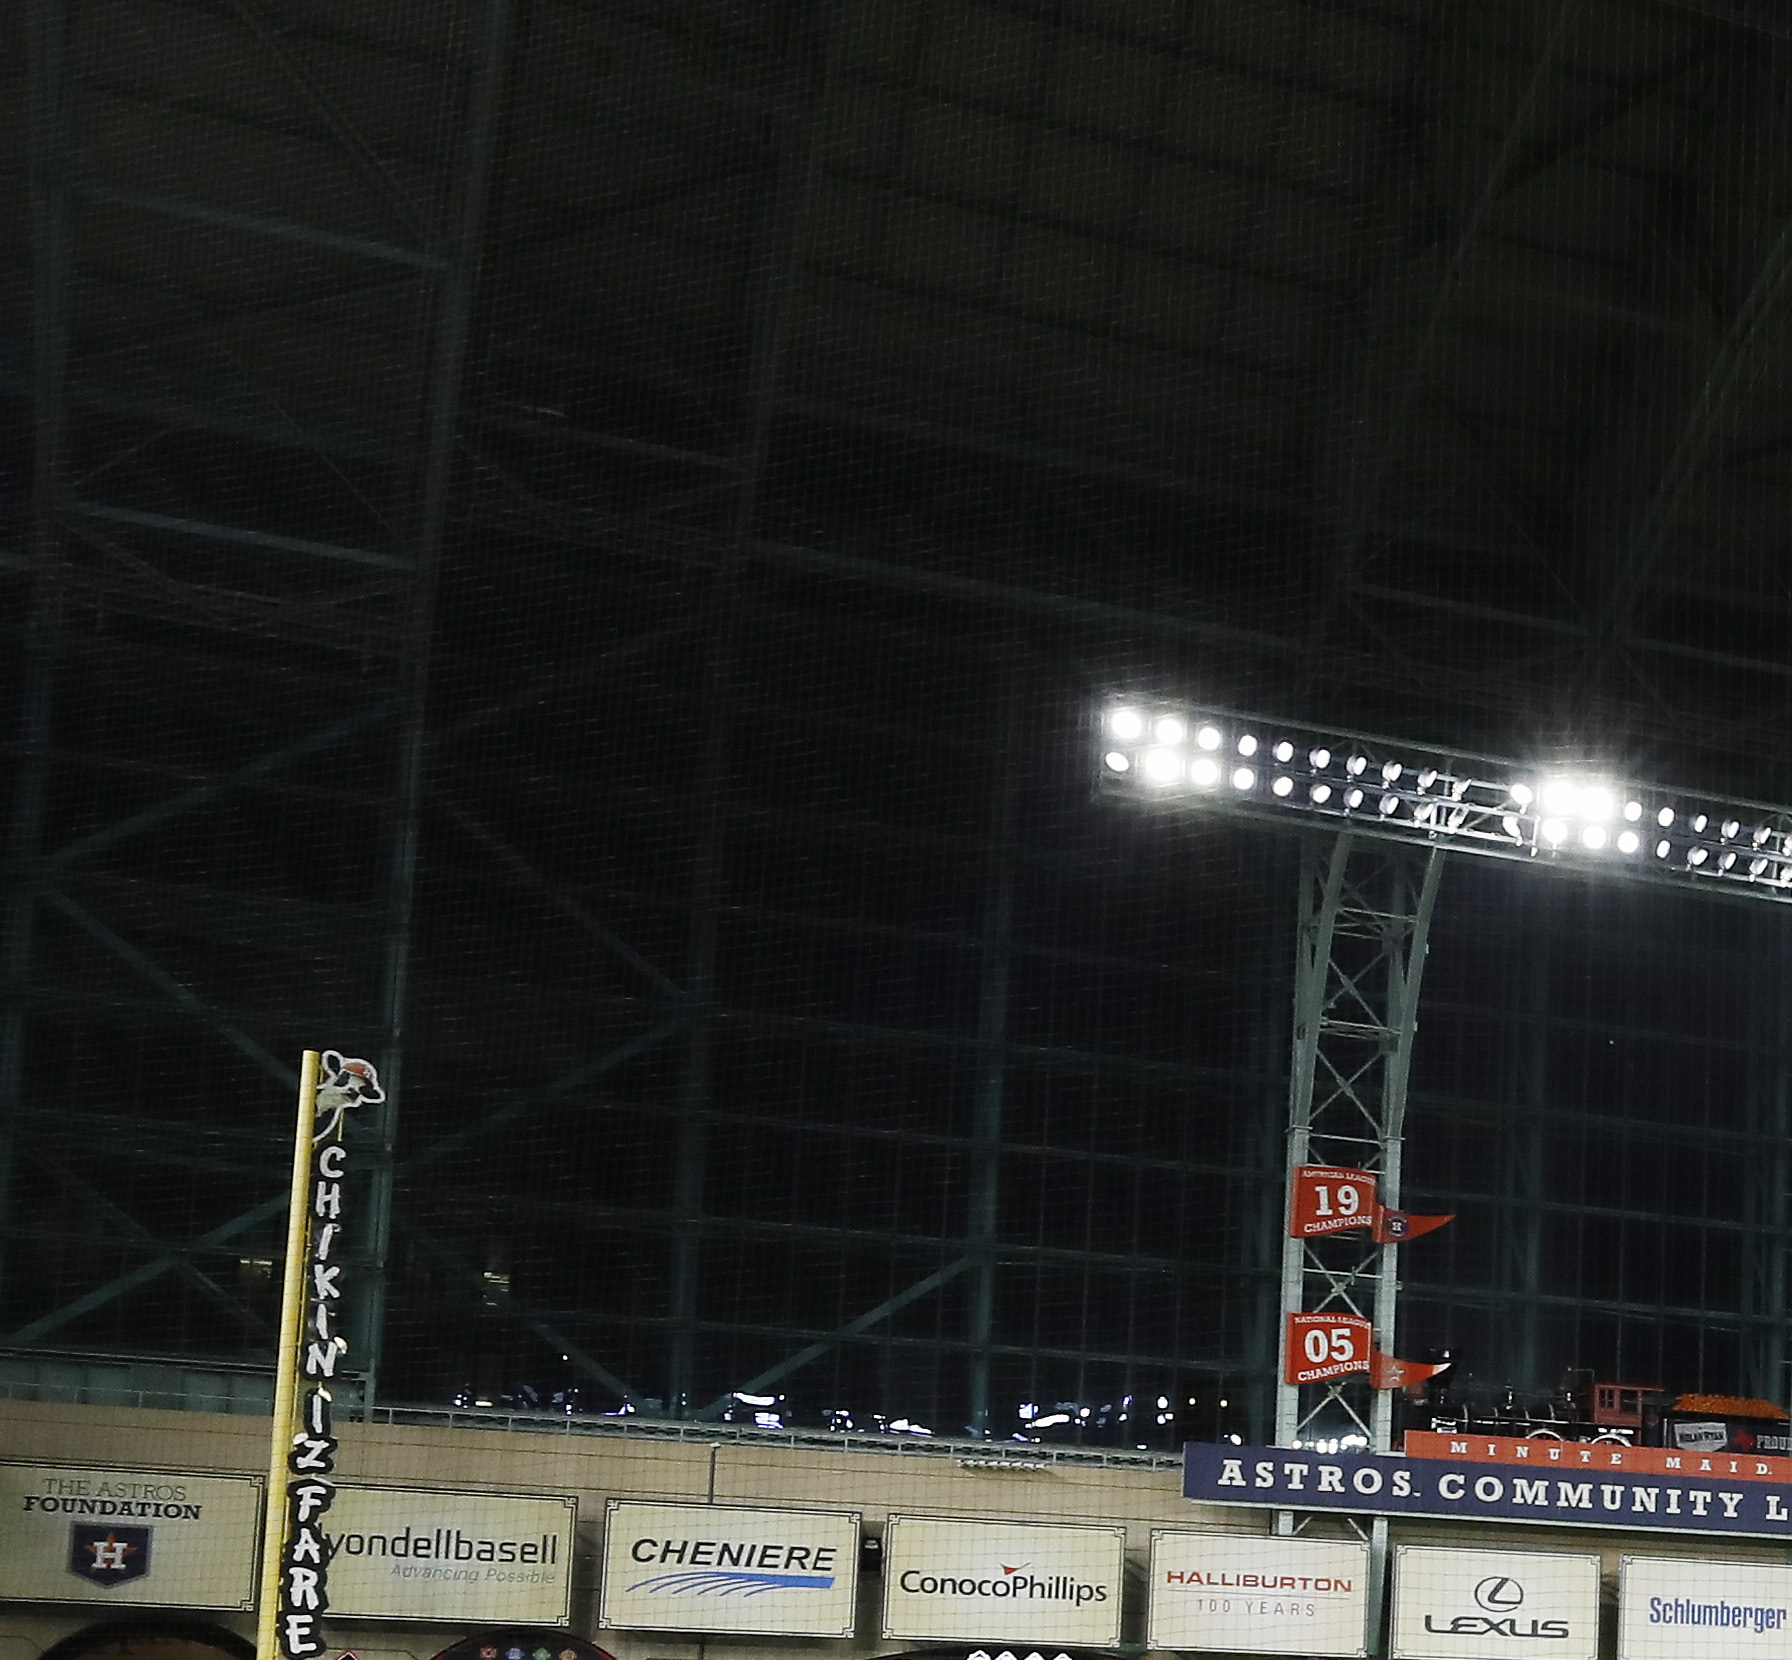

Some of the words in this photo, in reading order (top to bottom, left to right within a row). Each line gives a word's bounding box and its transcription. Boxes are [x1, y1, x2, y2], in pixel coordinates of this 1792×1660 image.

[1315, 1185, 1359, 1217] 19
[1304, 1216, 1373, 1234] CHAMPIONS
[306, 1146, 345, 1379] CHIKIN
[1304, 1328, 1354, 1363] 05
[1298, 1360, 1370, 1381] CHAMPIONS
[1450, 1440, 1623, 1467] MINUTE
[1665, 1456, 1768, 1475] MAID
[44, 1478, 91, 1497] THE
[97, 1479, 187, 1502] ASTROS
[1217, 1460, 1413, 1498] ASTROS
[1438, 1473, 1744, 1520] COMMUNITY
[23, 1496, 202, 1520] FOUNDATION
[285, 1487, 324, 1653] FARE
[631, 1537, 837, 1573] CHENIERE
[391, 1564, 479, 1584] Advancing
[485, 1567, 556, 1585] Possible
[900, 1569, 1108, 1608] ConocoPhillips
[1167, 1570, 1352, 1593] HALLIBURTON
[1198, 1599, 1230, 1613] 100
[1245, 1600, 1316, 1617] YEARS
[1649, 1596, 1786, 1634] Schlumberger
[1425, 1614, 1569, 1639] LEXUS
